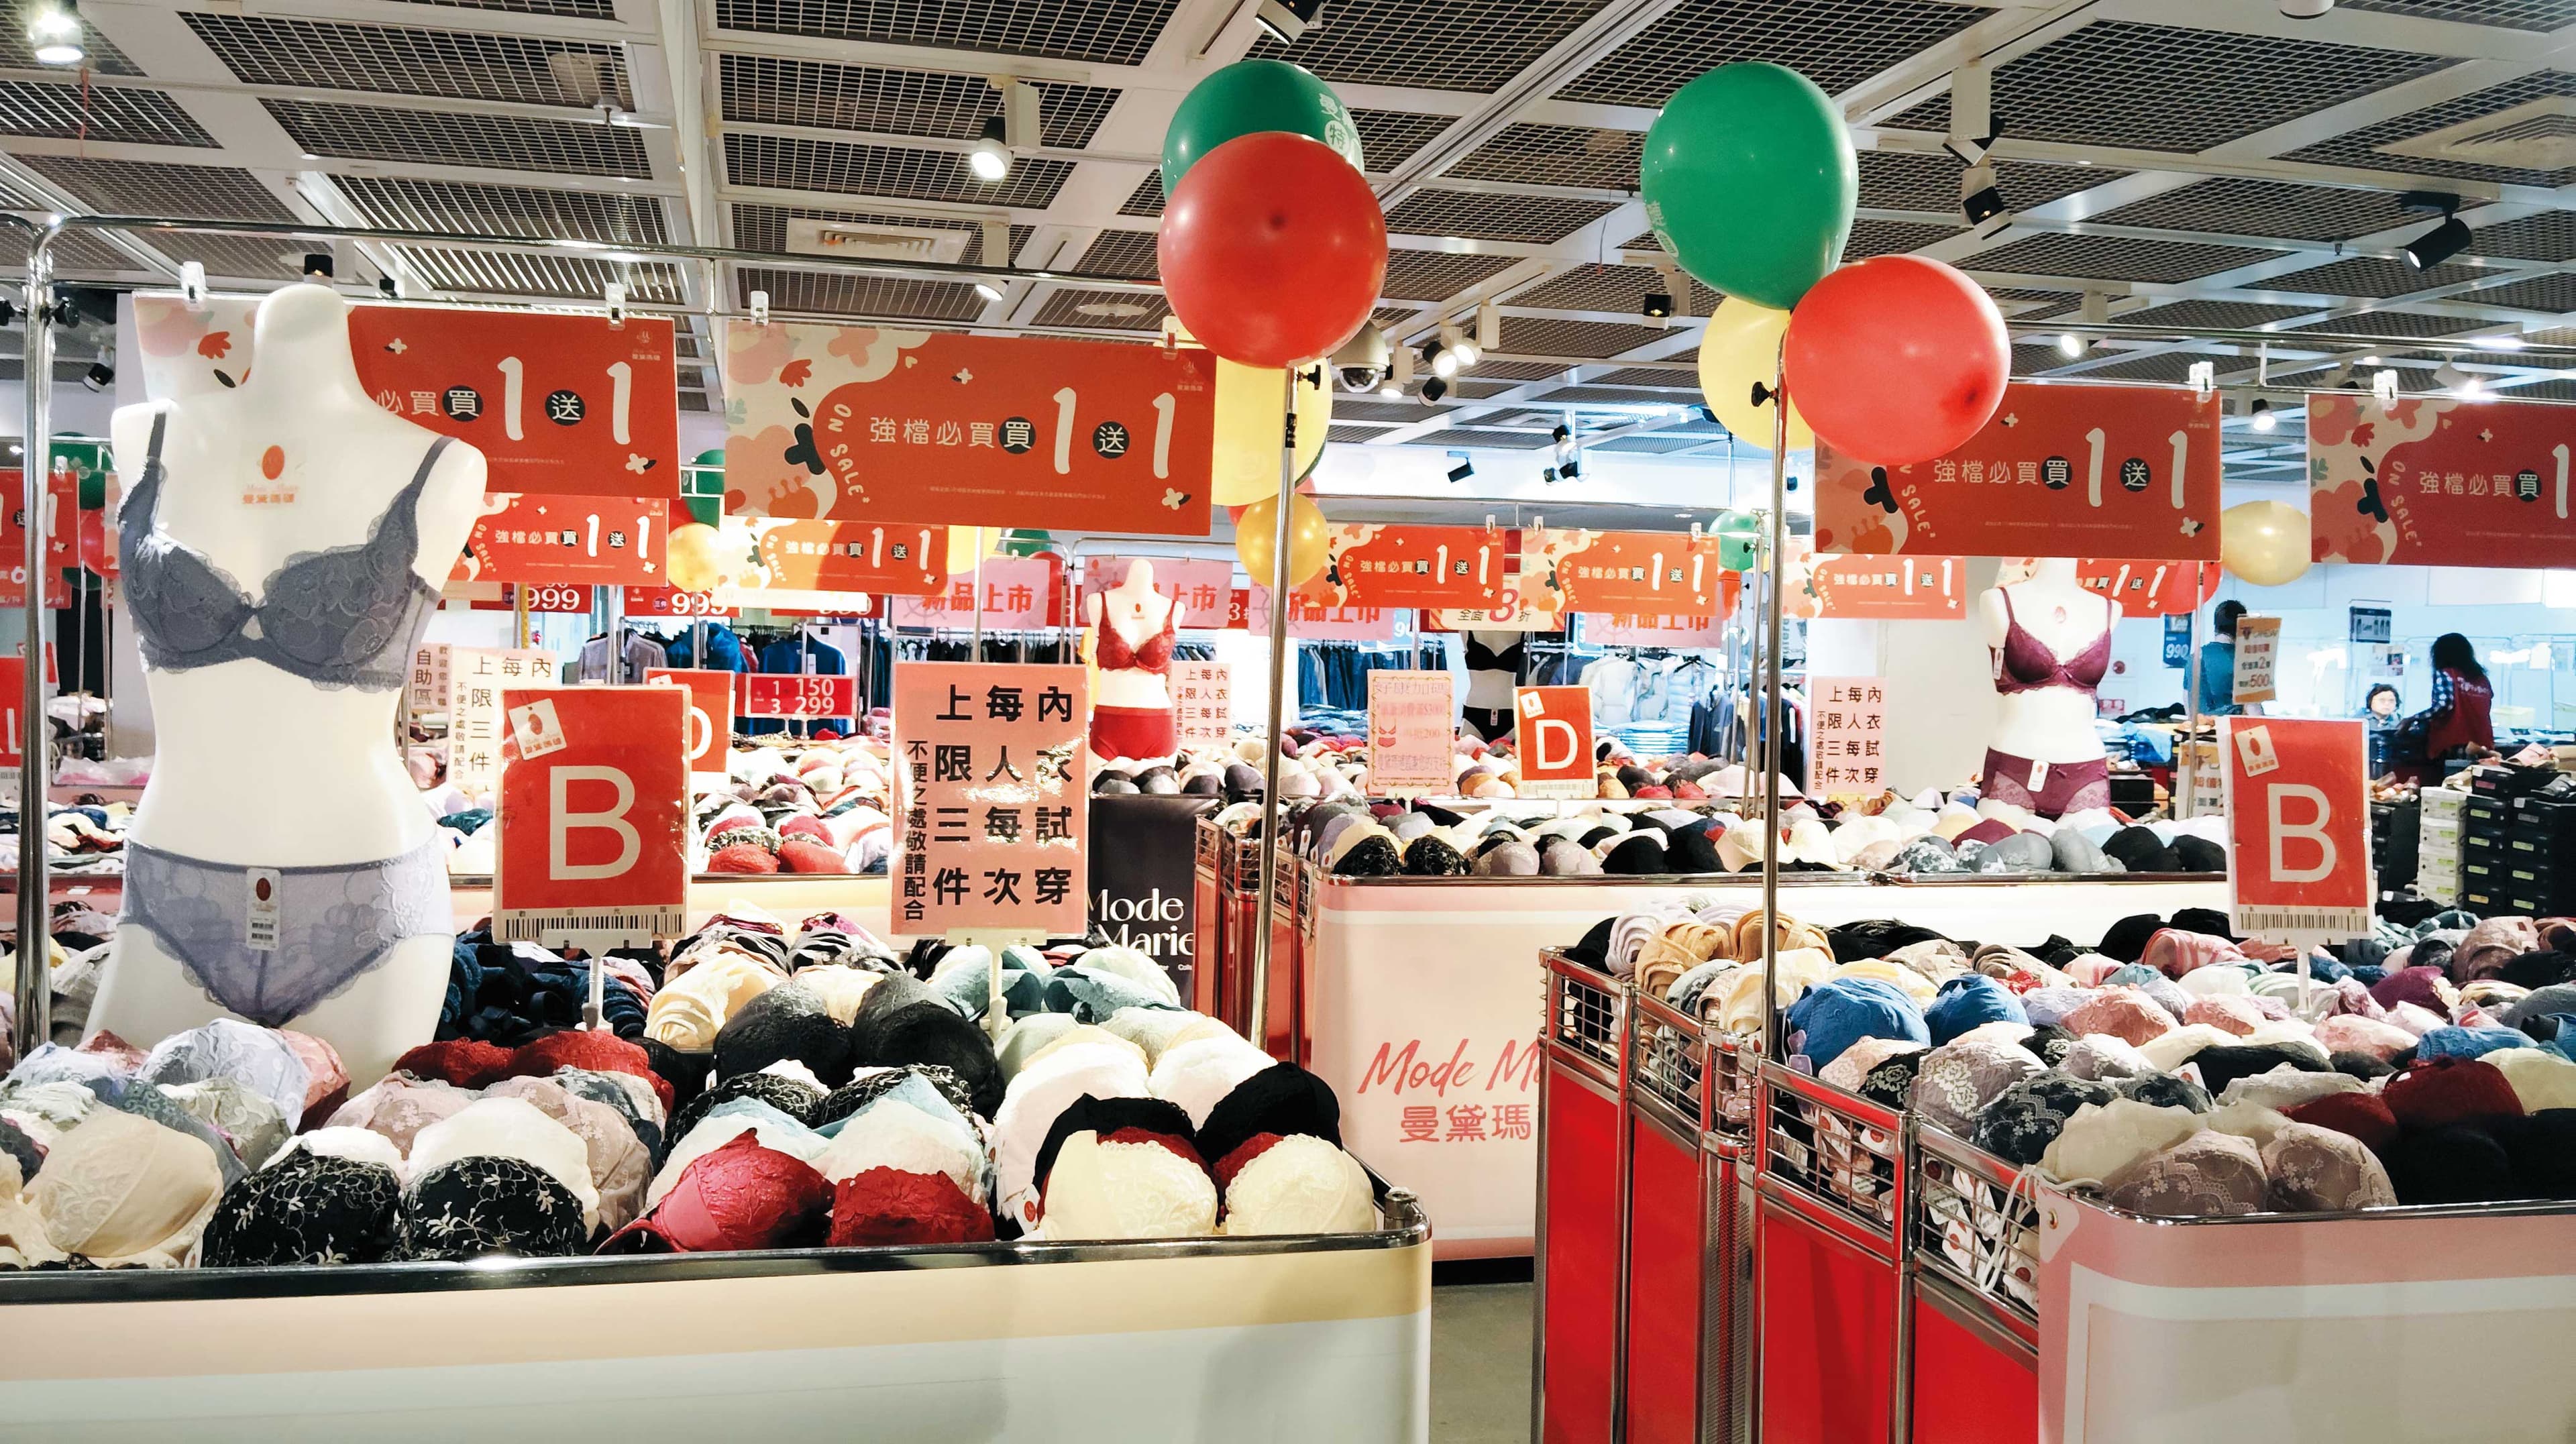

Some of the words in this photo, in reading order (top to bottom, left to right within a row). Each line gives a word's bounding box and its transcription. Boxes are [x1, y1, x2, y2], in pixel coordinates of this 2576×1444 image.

[828, 404, 852, 433] ON
[870, 387, 1177, 480] 強檔必買買1送1
[830, 443, 864, 496] SALE
[1934, 427, 2188, 509] 強檔必買買1送1
[2388, 461, 2406, 486] ON
[2419, 443, 2569, 519] 強檔必買買1
[474, 524, 488, 539] ON
[1901, 484, 1931, 531] SALE
[2390, 495, 2418, 540] SALE
[495, 514, 650, 559] 強檔必買買1送1
[1360, 544, 1491, 586] 強檔必買買1送1
[415, 649, 433, 706] 自助區
[773, 680, 780, 696] 1
[796, 678, 835, 697] 150
[771, 698, 781, 714] 3
[795, 696, 835, 715] 299
[1535, 719, 1578, 770] D
[932, 684, 973, 905] 上限三件
[983, 685, 1024, 906] 每人每次
[1034, 685, 1074, 905] 內衣試穿
[549, 765, 641, 881] B
[2267, 783, 2337, 883] B
[1357, 1038, 1474, 1098] Mode
[1399, 1104, 1532, 1143] 曼黛瑪
